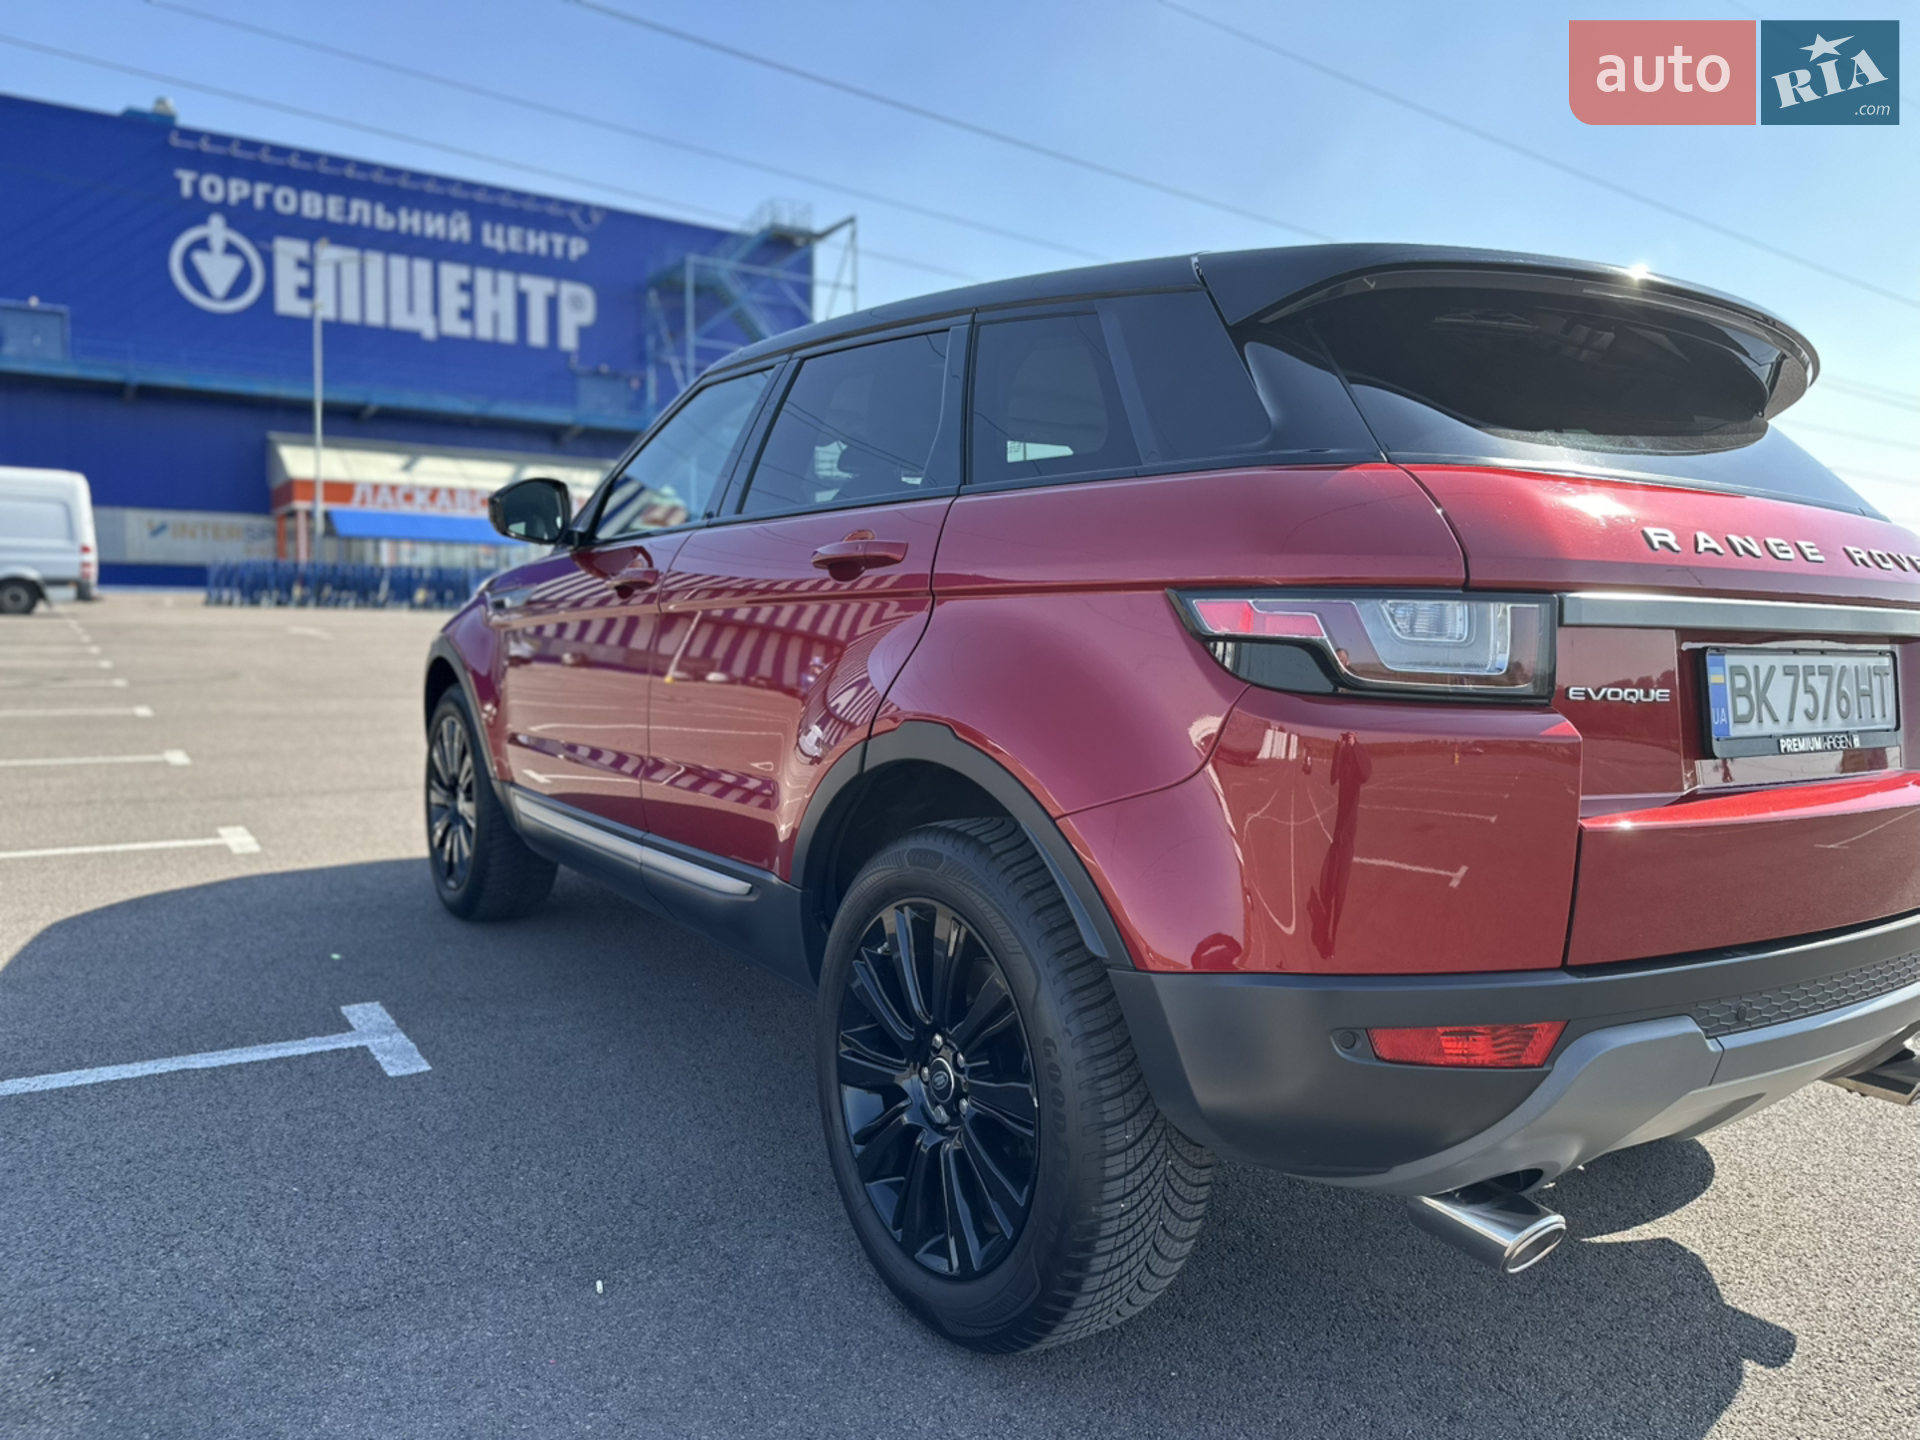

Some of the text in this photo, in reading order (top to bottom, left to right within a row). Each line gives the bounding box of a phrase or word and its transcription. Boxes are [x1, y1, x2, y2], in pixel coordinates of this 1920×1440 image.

[173, 168, 590, 261] ТОРГОВЕЛЬНИЙ ЦЕНТР
[272, 235, 598, 352] ЕПІЦЕНТР
[1642, 527, 1826, 563] RANGE
[1568, 686, 1671, 704] EVOQUE
[1783, 664, 1850, 723] 7576
[1712, 708, 1728, 725] UA
[1779, 736, 1822, 754] PREMIUM
